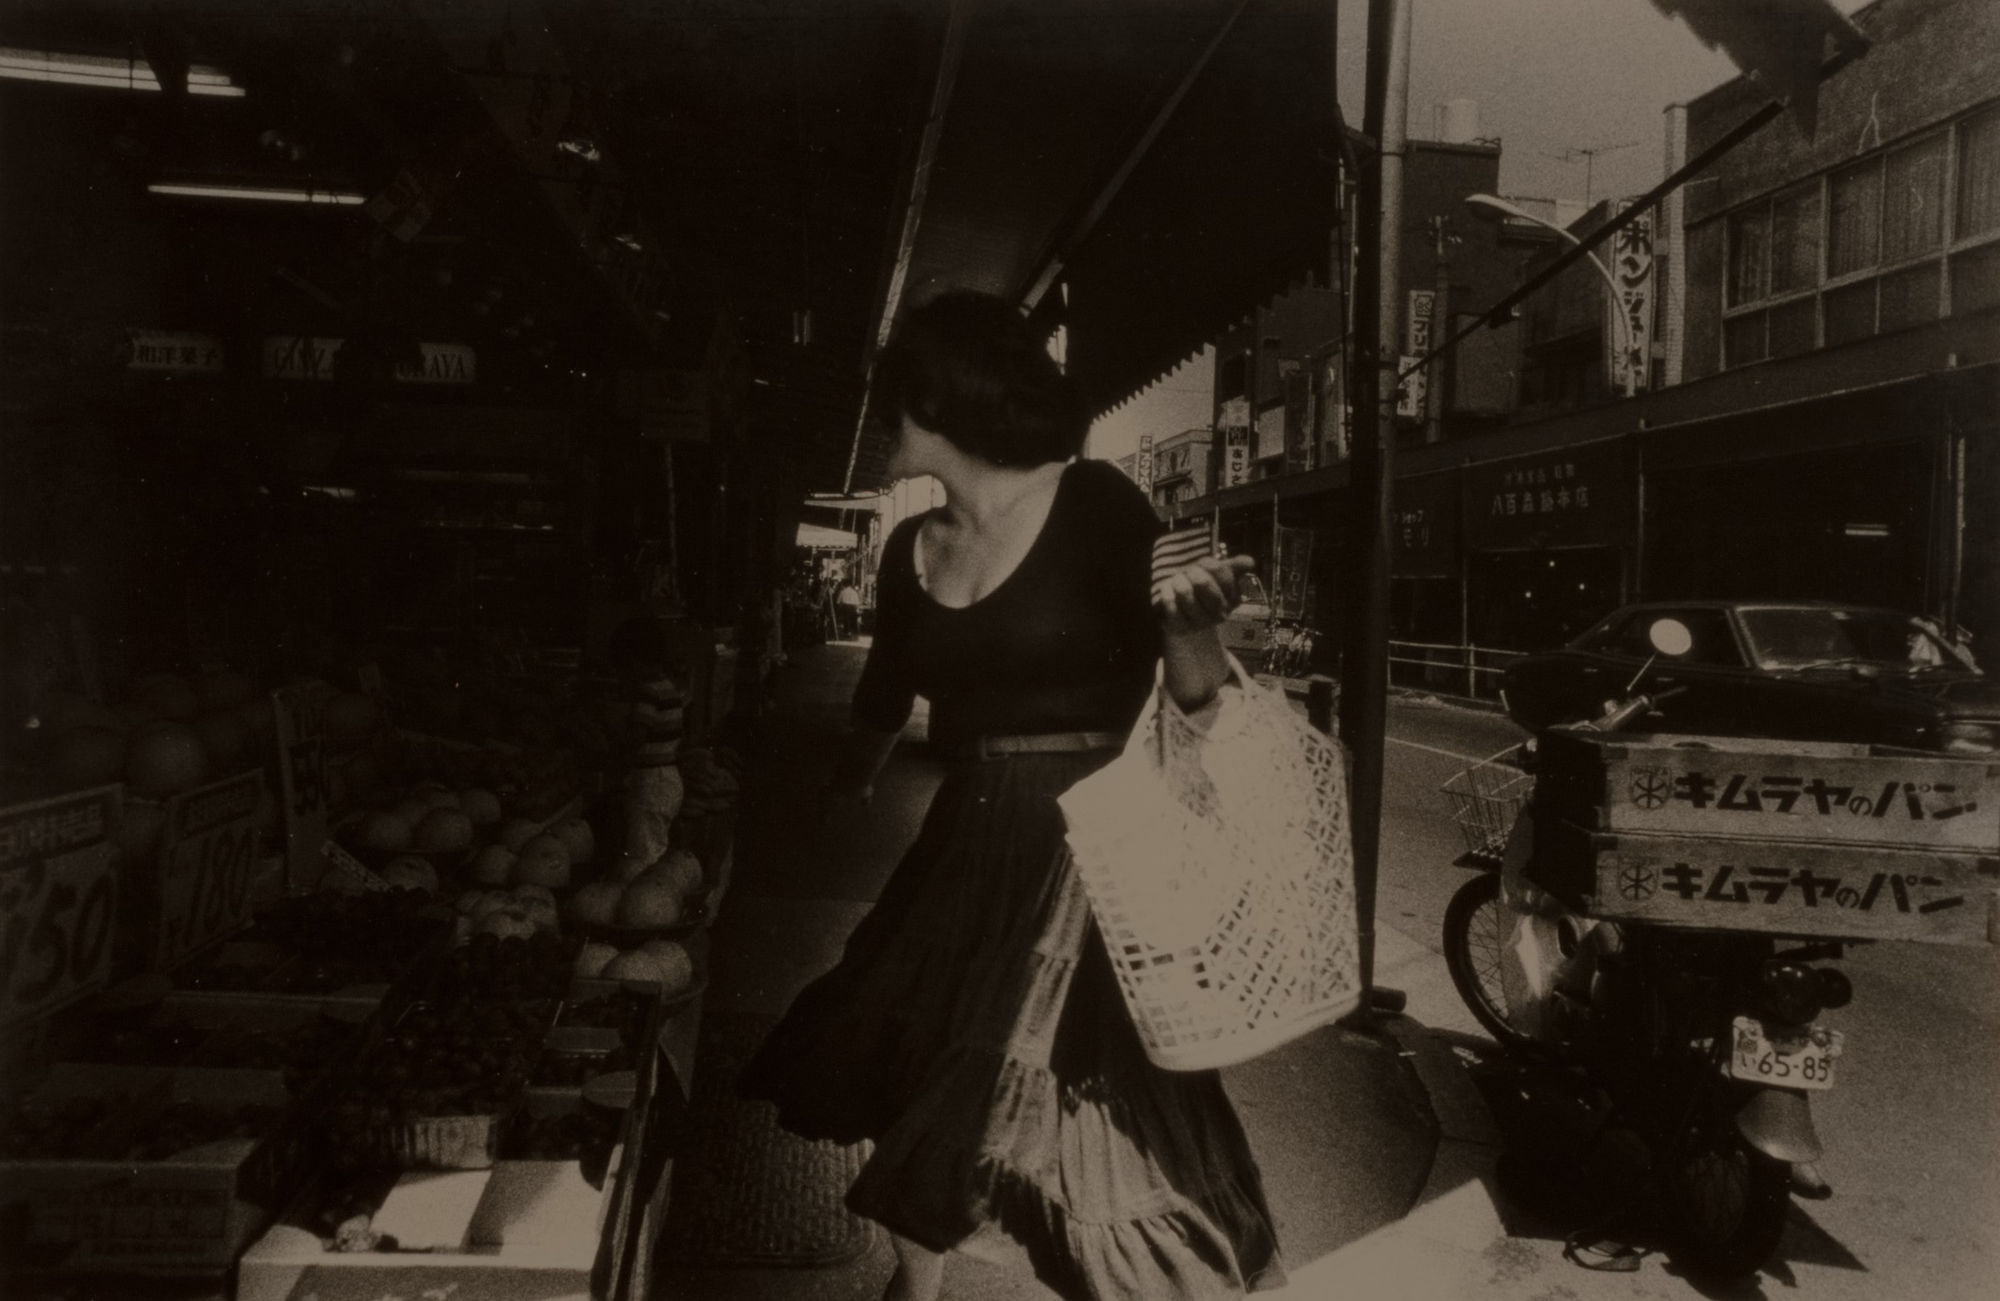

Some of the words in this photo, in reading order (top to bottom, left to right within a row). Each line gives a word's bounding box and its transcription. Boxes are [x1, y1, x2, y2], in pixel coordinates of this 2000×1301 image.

[1673, 771, 1978, 821] キムラヤのパン
[1661, 862, 1966, 915] キムラヤのパン
[1758, 1051, 1829, 1082] 65-85
